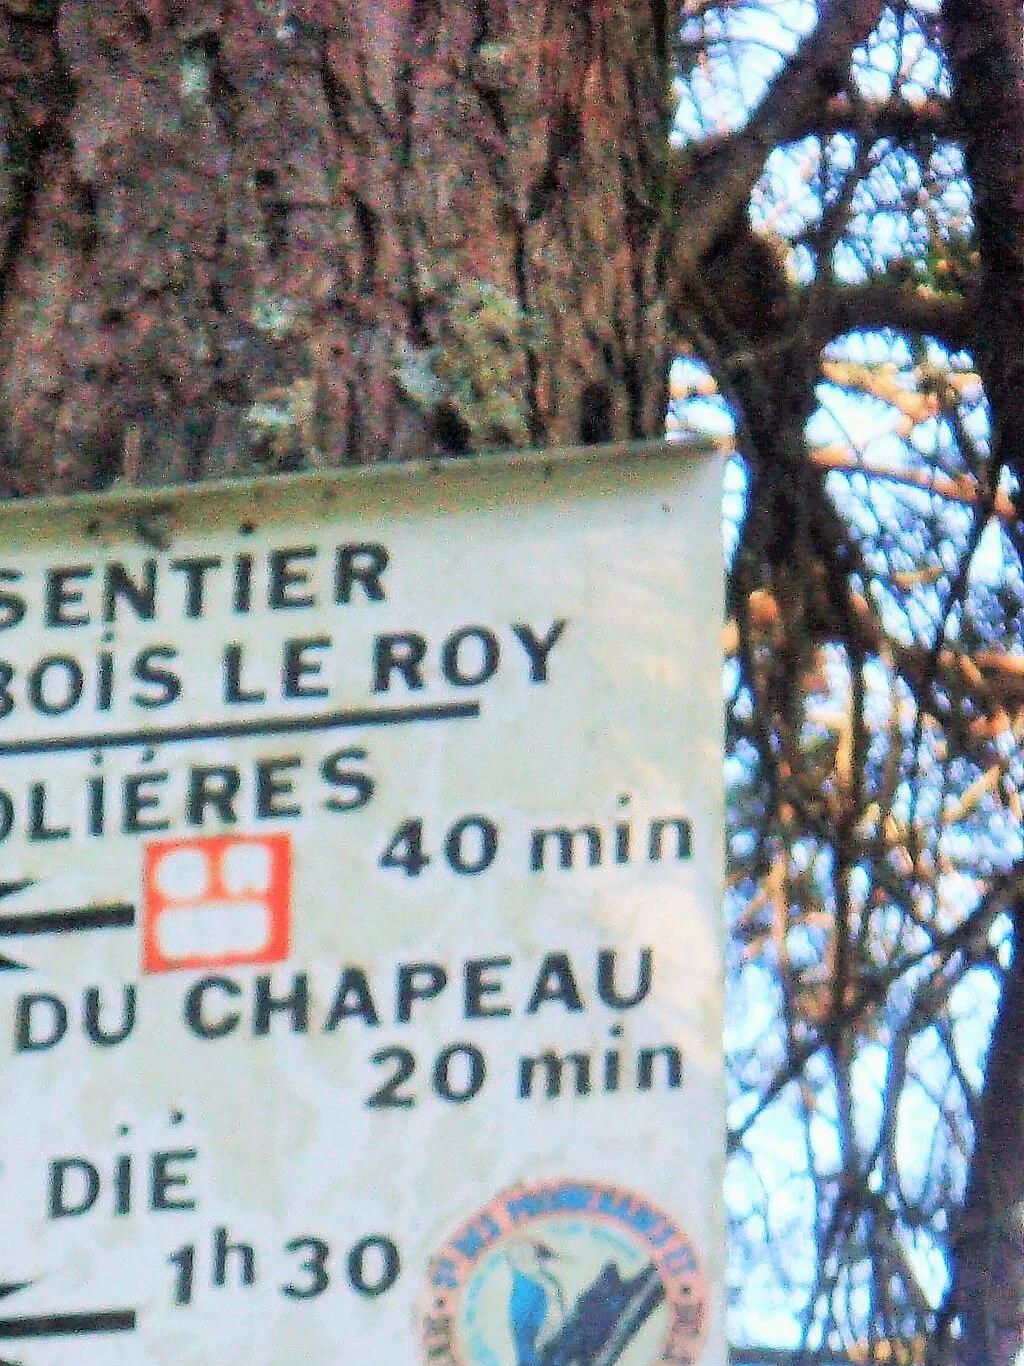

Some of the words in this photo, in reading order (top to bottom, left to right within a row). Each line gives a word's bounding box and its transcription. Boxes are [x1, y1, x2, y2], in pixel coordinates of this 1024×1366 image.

[224, 636, 332, 704] LE
[372, 620, 566, 693] ROY
[380, 815, 499, 877] 40
[529, 796, 694, 873] min
[15, 985, 137, 1053] DU
[183, 947, 654, 1038] CHAPEAU
[366, 1043, 488, 1109] 20
[517, 1025, 684, 1099] min
